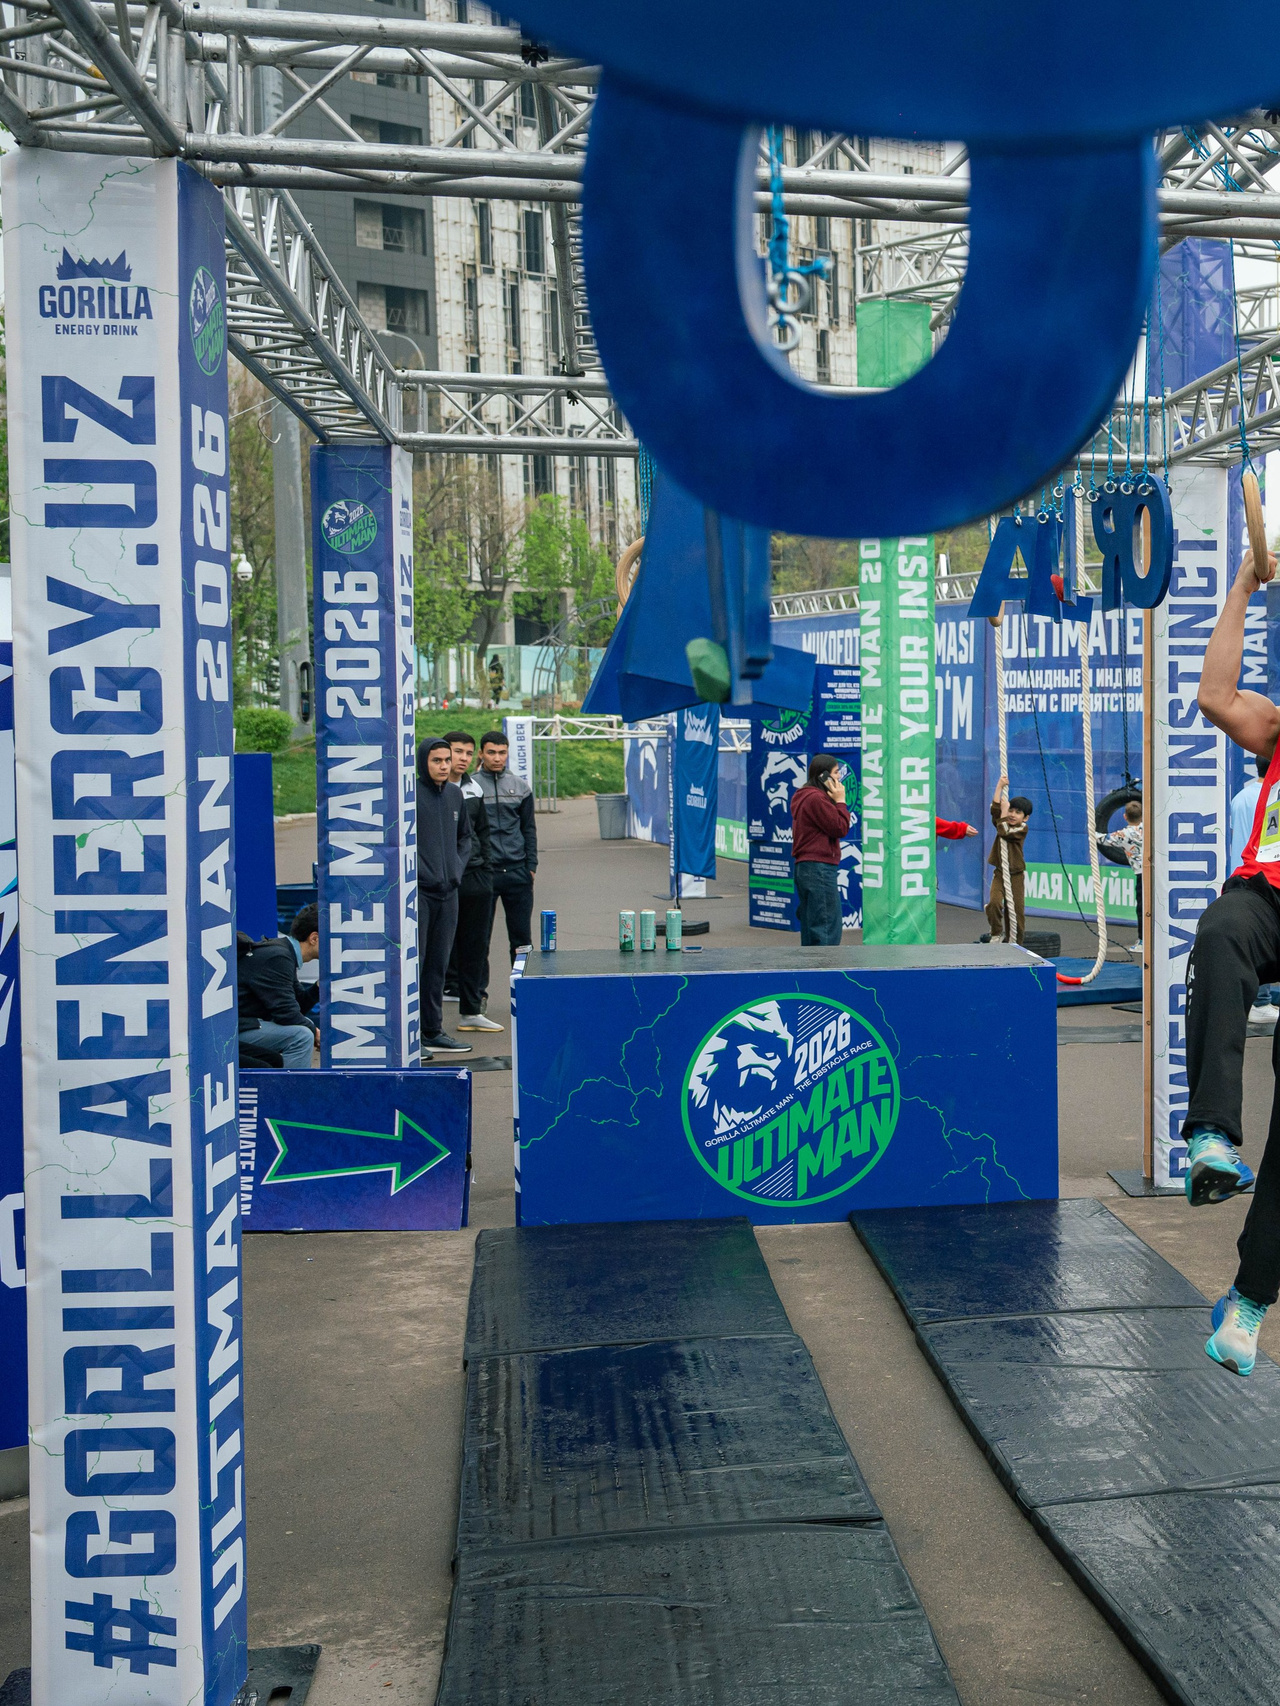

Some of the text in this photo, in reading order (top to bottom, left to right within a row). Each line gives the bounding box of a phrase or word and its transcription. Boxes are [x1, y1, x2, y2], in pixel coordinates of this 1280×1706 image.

[39, 285, 153, 320] GORILLA
[55, 324, 139, 336] ENERGY DRINK
[329, 514, 376, 550] ULTIMATE
[349, 504, 364, 524] 2026
[351, 526, 377, 552] MAN
[860, 600, 882, 687] MAN
[1001, 608, 1144, 659] ULTIMATE
[1168, 528, 1218, 787] INSTINCT
[1242, 606, 1268, 684] MAN
[899, 635, 931, 741] YOUR
[1002, 668, 1082, 691] КОМАНДНЫЕ
[1003, 693, 1047, 713] ЗАБЕГИ
[1049, 693, 1059, 713] С
[515, 723, 526, 742] BER
[517, 745, 528, 771] KUCH
[322, 571, 387, 1068] MATE MAN 2026
[862, 703, 885, 889] ULTIMATE
[900, 756, 931, 898] POWER
[1267, 816, 1278, 831] A
[1024, 870, 1063, 901] МАЯ
[1168, 812, 1218, 960] YOUR
[41, 375, 179, 1676] #GORILLAENERGY.UZ
[191, 404, 245, 1630] ULTIMATE MAN 2026
[793, 1011, 851, 1087] 2026
[704, 1130, 741, 1148] GORILLA
[740, 1106, 777, 1137] ULTIMATE
[796, 1078, 813, 1093] THE
[811, 1051, 851, 1082] OBSTACLE
[849, 1040, 873, 1056] RACE
[717, 1055, 892, 1189] ULTIMATE
[796, 1097, 894, 1200] MAN
[239, 1176, 254, 1216] MAN
